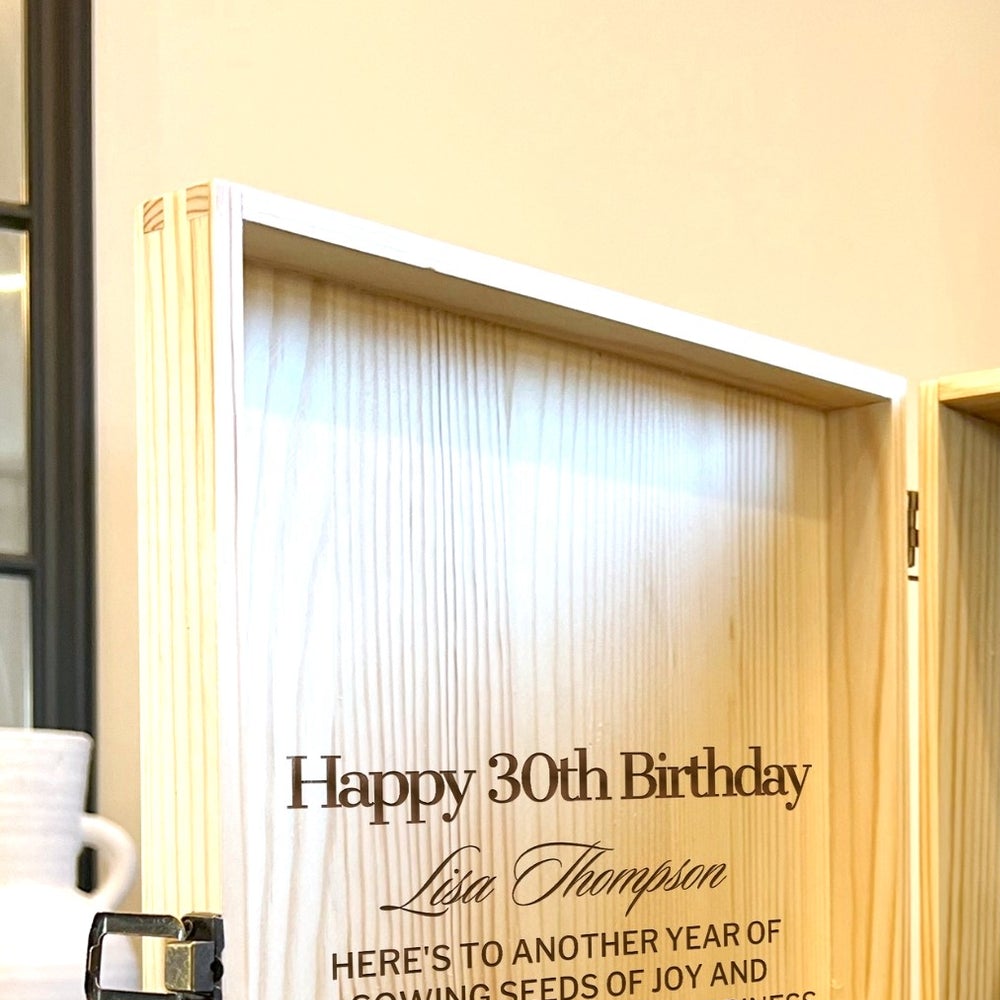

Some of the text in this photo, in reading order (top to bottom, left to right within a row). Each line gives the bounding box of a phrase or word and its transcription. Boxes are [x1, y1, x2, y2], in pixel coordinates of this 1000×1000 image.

[286, 746, 812, 825] Happy 30th Birthday
[380, 840, 727, 917] Lisa Thompson
[332, 919, 782, 980] HERE'S TO ANOTHER YEAR OF
[606, 969, 644, 996] OF
[652, 963, 700, 992] JOY
[710, 958, 767, 987] AND
